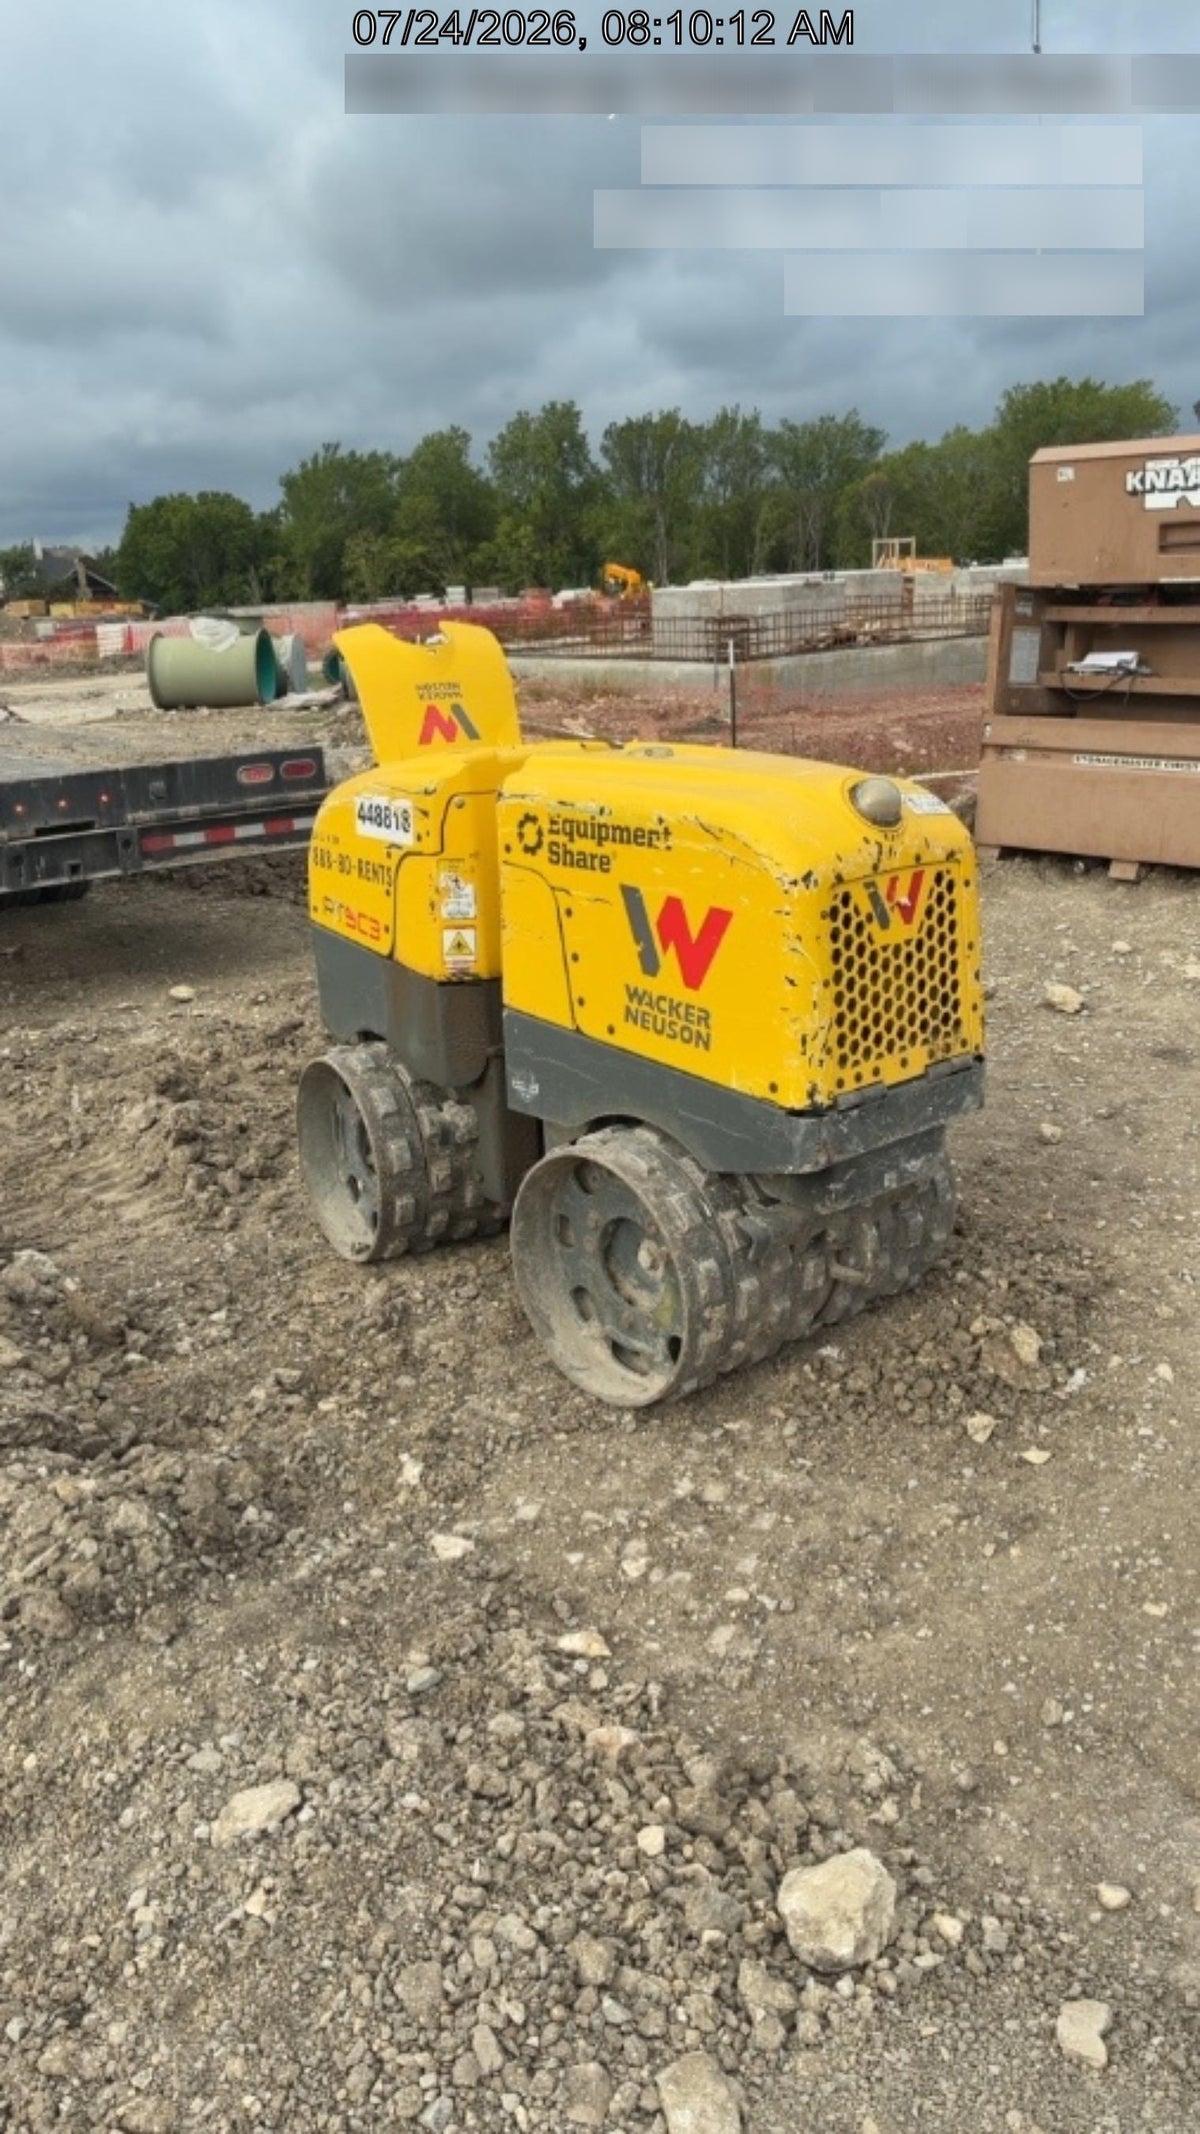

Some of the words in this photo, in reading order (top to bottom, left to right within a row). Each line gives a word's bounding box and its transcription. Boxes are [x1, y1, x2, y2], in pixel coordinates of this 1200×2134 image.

[547, 814, 673, 851] Equipment
[548, 841, 611, 873] Share
[624, 983, 711, 1029] WACKER
[624, 1005, 711, 1051] NEUSON
